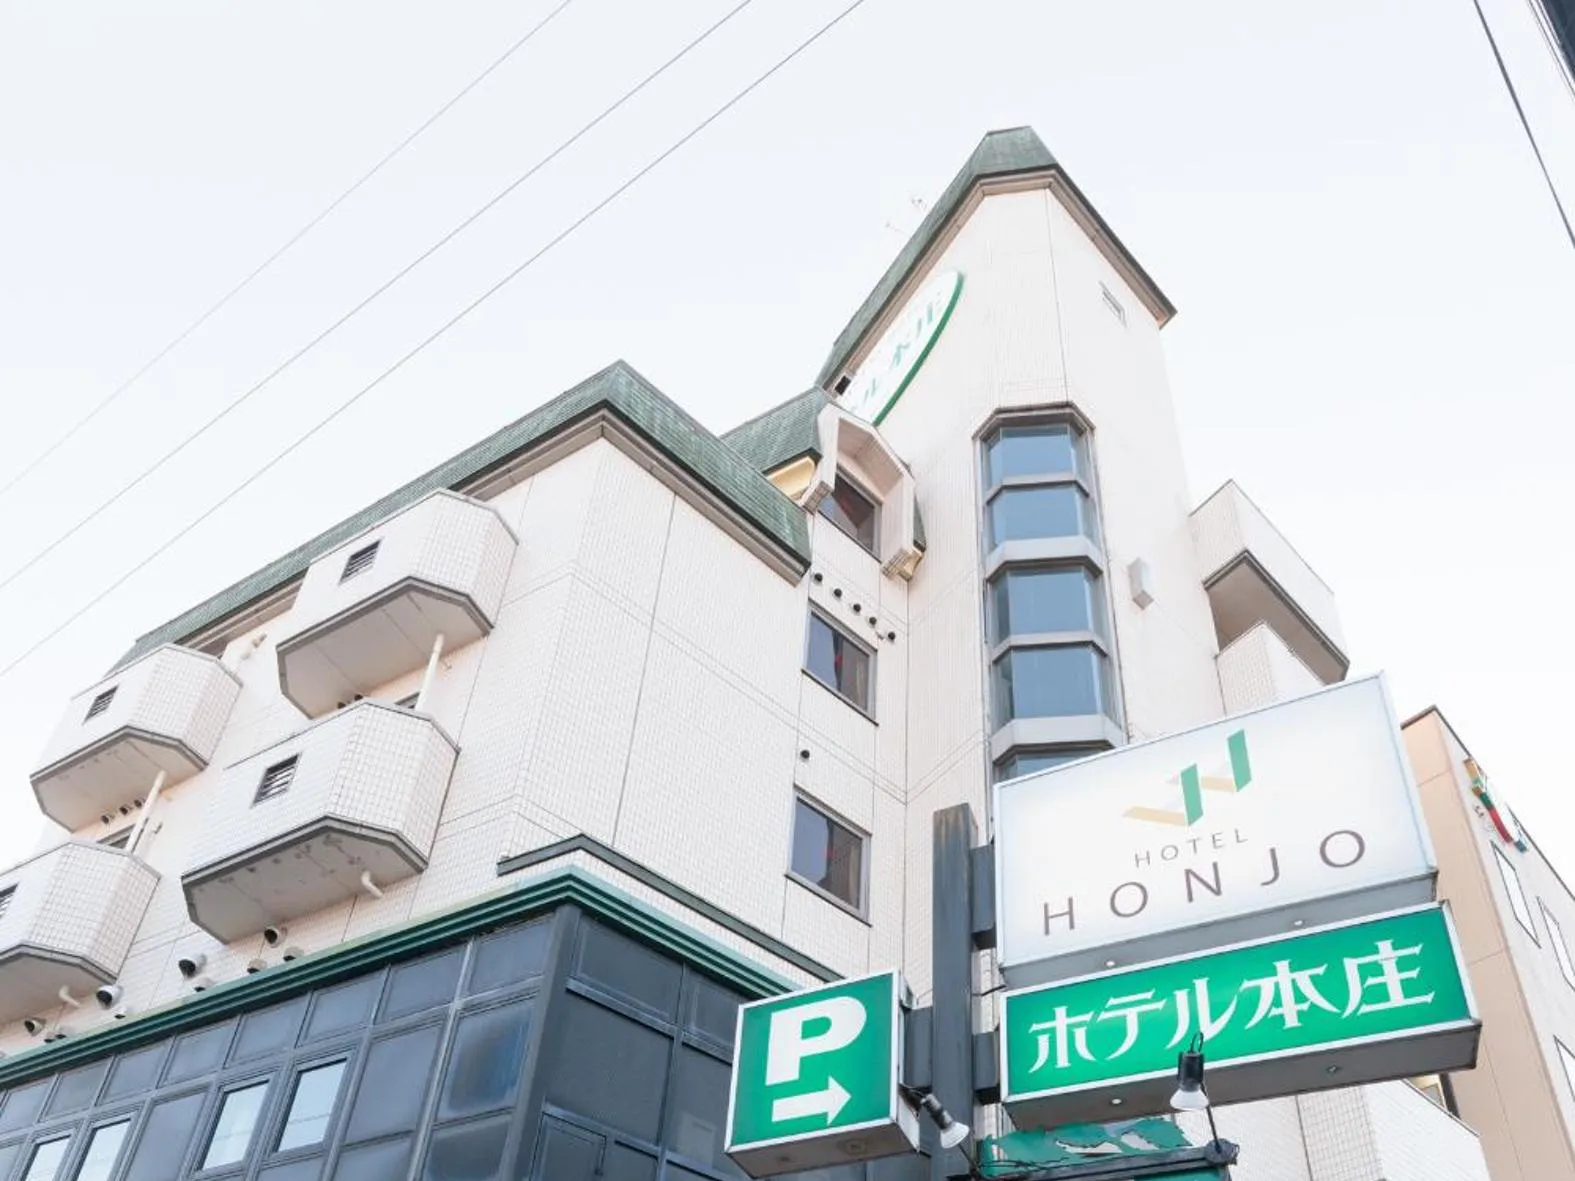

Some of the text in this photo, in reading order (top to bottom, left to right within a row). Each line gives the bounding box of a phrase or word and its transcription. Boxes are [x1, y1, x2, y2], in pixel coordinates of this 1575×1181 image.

[1043, 829, 1366, 936] HONJO
[1135, 828, 1249, 868] HOTEL
[765, 996, 867, 1086] P
[1027, 938, 1436, 1074] ホテル本庄
